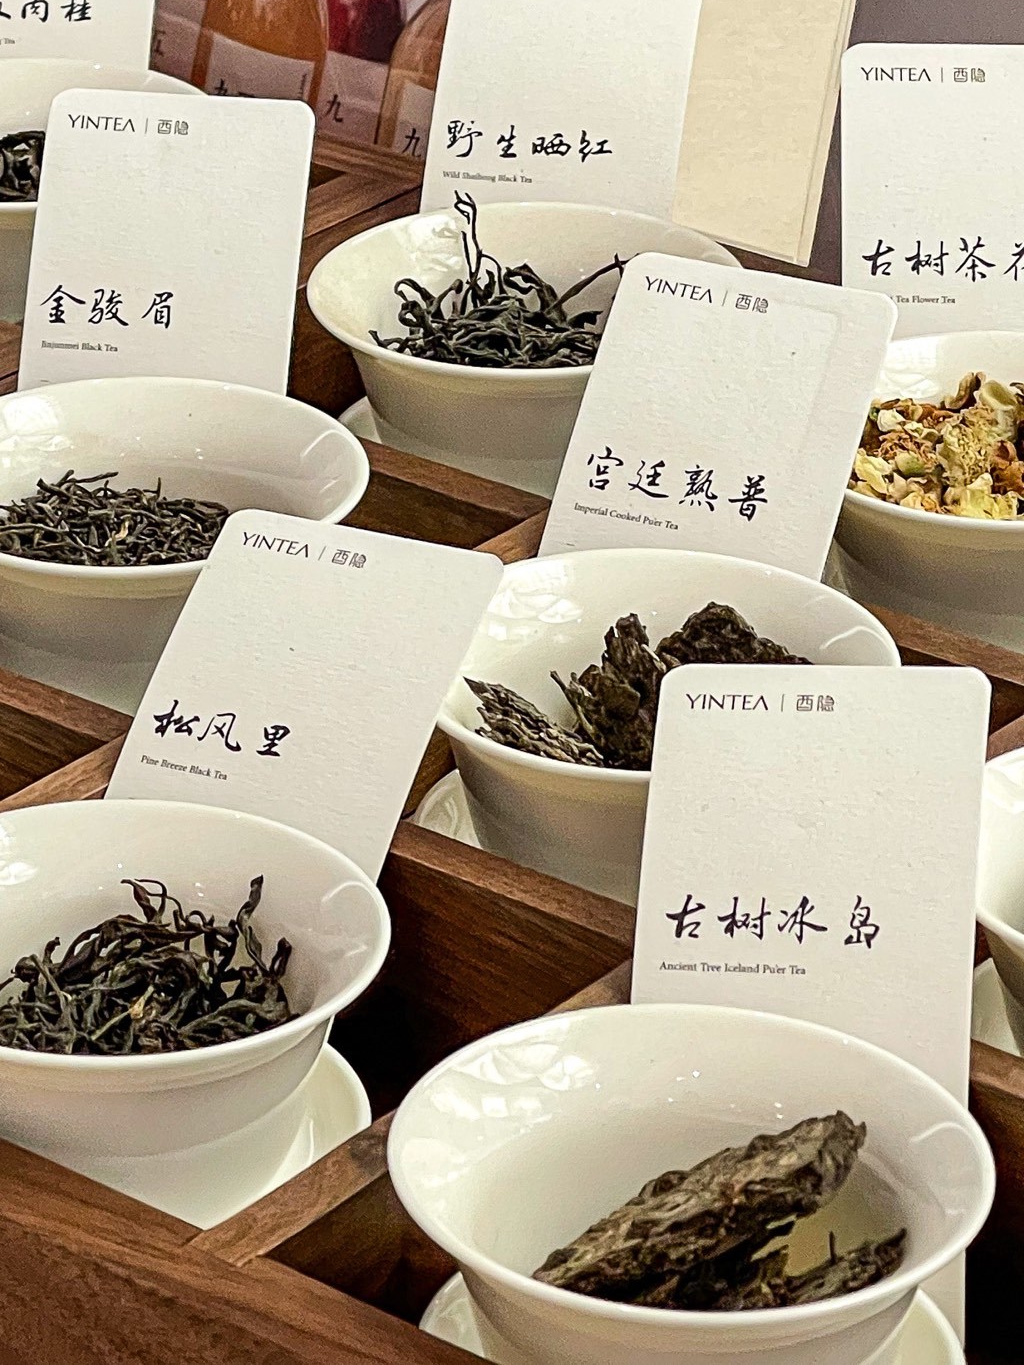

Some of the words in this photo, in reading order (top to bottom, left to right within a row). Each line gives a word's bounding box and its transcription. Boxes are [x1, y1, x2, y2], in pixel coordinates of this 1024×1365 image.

[861, 67, 931, 82] YINTEA
[68, 114, 135, 133] YINTEA
[445, 118, 613, 163] 野生晒红
[644, 275, 714, 305] YINTEA
[896, 295, 909, 303] Tea
[912, 296, 939, 304] Flower
[40, 284, 173, 328] 金骏眉
[586, 446, 769, 522] 宫廷熟普
[574, 502, 608, 515] Imperial
[609, 509, 641, 523] Cooked
[665, 520, 678, 530] Tea
[242, 531, 310, 559] YINTEA
[685, 693, 769, 711] YINTEA
[153, 699, 291, 758] 松风里
[140, 755, 159, 766] Pine
[160, 759, 187, 772] Breeze
[189, 765, 211, 777] Black
[214, 770, 228, 780] Tea
[666, 894, 880, 949] 古树冰岛
[659, 961, 697, 972] Ancient
[701, 963, 722, 972] Tree
[724, 963, 760, 974] Iceland
[789, 965, 806, 975] Tea
